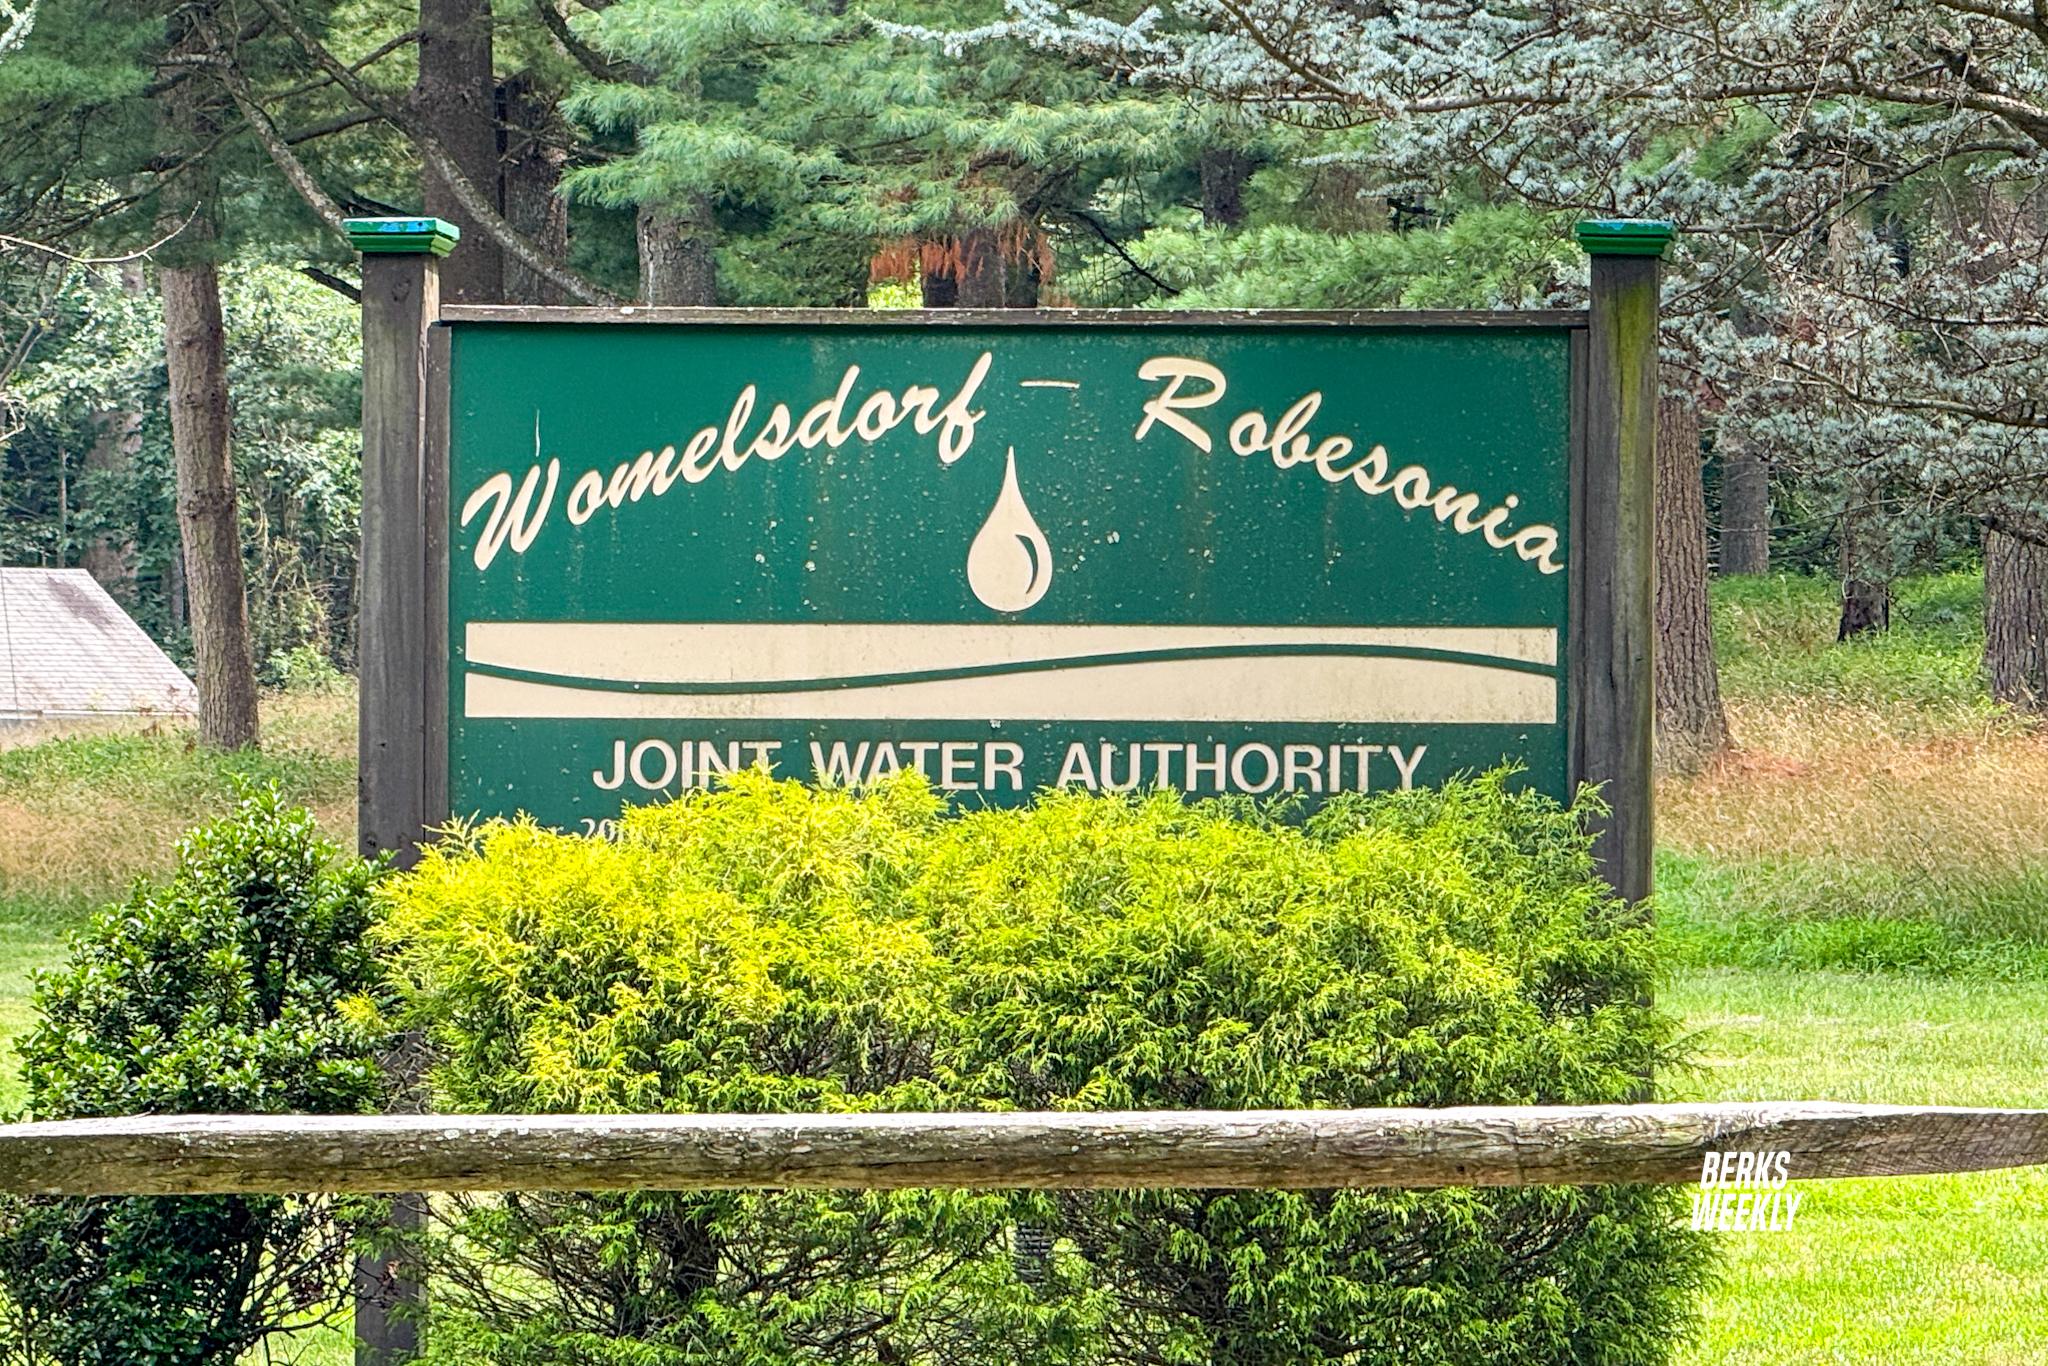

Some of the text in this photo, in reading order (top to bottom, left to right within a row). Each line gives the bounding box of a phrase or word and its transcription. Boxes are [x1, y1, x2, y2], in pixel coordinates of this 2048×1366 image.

[461, 352, 992, 571] Womelsdorf
[1135, 356, 1564, 575] Robesonia
[592, 739, 1427, 793] JOINT WATER AUTHORITY
